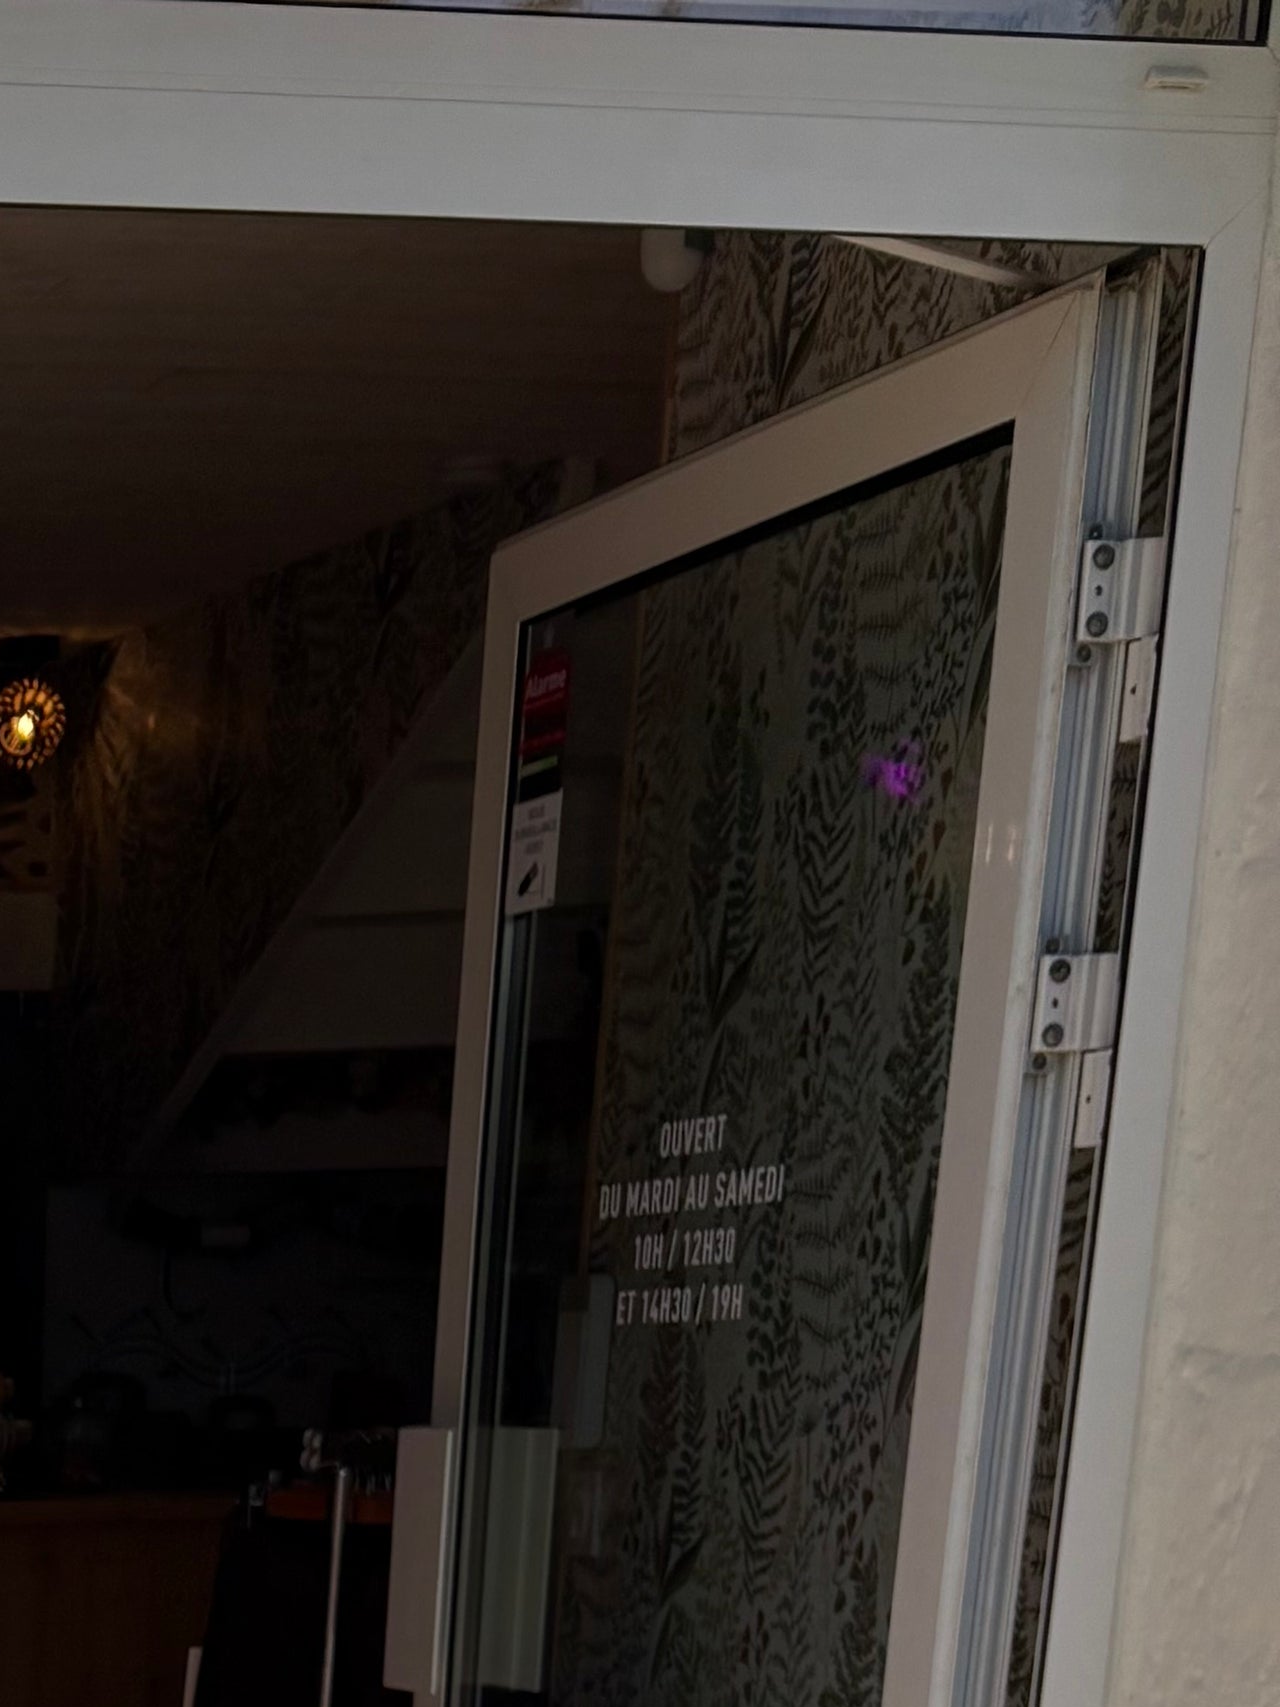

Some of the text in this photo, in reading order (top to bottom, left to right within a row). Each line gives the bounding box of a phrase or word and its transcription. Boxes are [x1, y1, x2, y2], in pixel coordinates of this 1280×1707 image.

[660, 1115, 727, 1158] OUVERT
[598, 1165, 784, 1220] DU MARDI AU SAMEDI
[634, 1232, 664, 1270] 10H
[682, 1225, 736, 1268] 12H30
[615, 1290, 637, 1327] ET
[641, 1286, 692, 1325] 14H30
[710, 1283, 744, 1321] 19H
